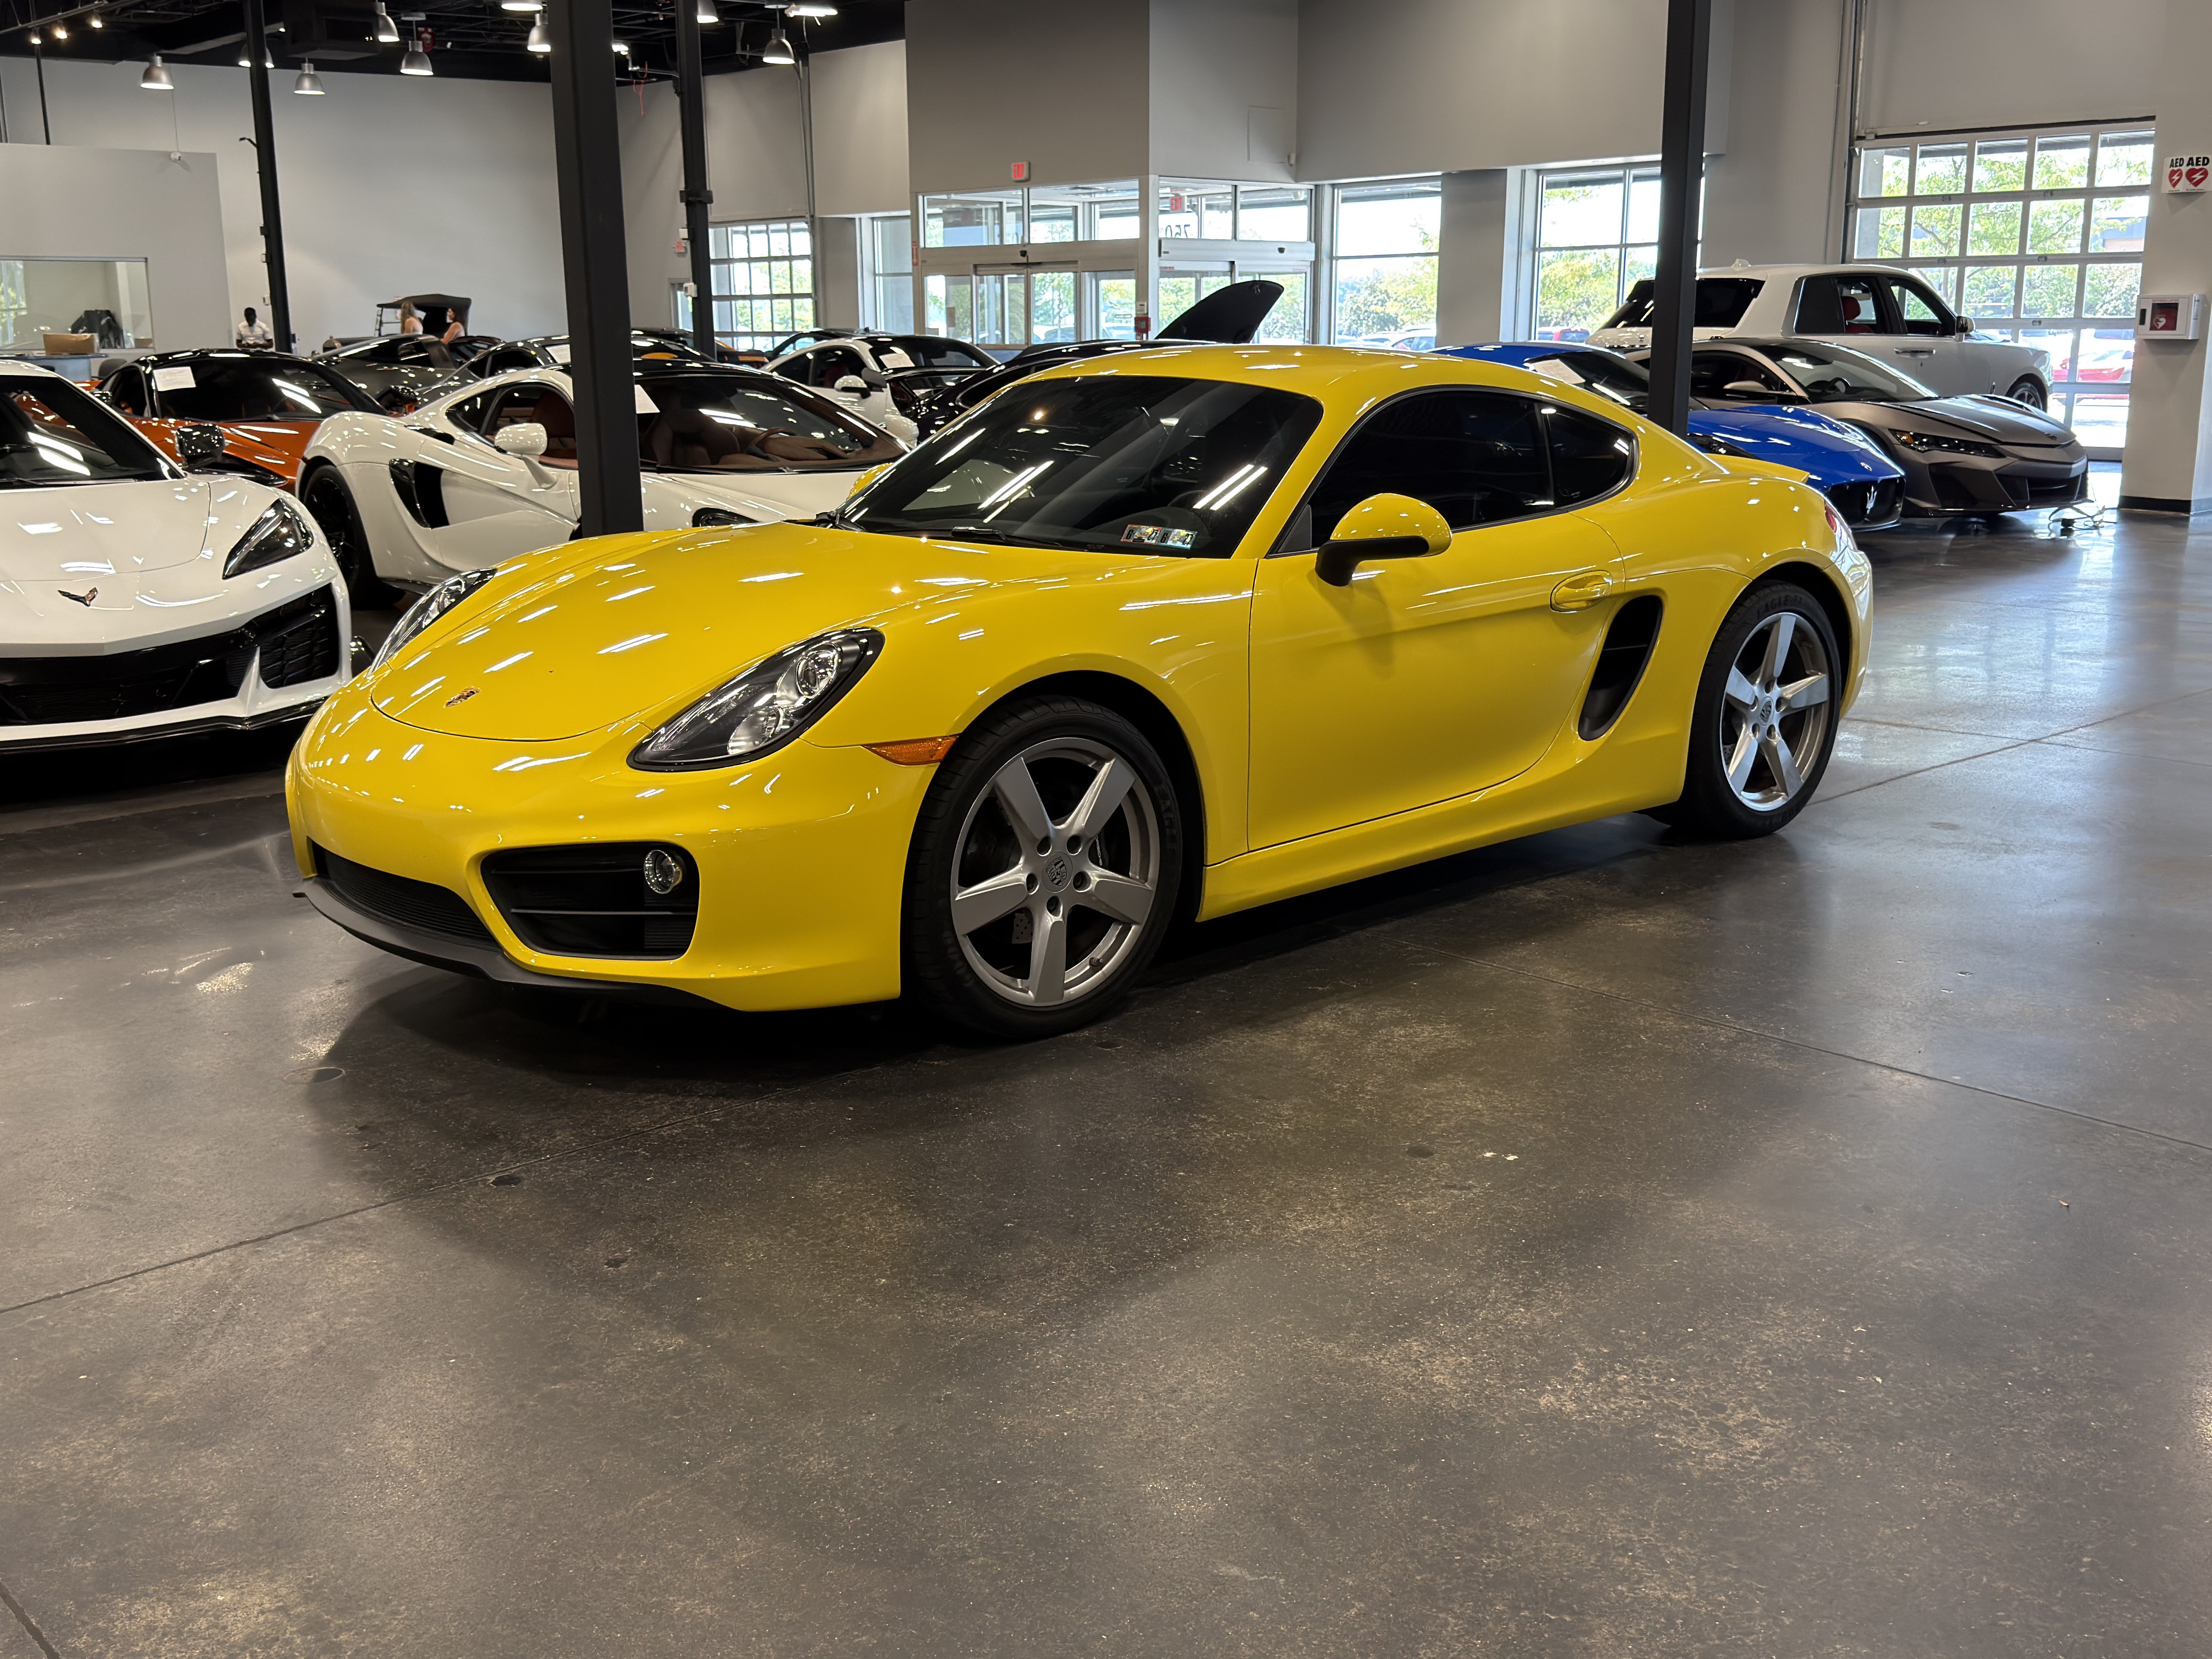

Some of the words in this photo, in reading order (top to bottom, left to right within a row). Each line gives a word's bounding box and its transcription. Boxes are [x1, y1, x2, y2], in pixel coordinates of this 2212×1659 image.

[2169, 158, 2184, 168] AED
[2186, 157, 2209, 167] AED
[1160, 532, 1168, 543] 6
